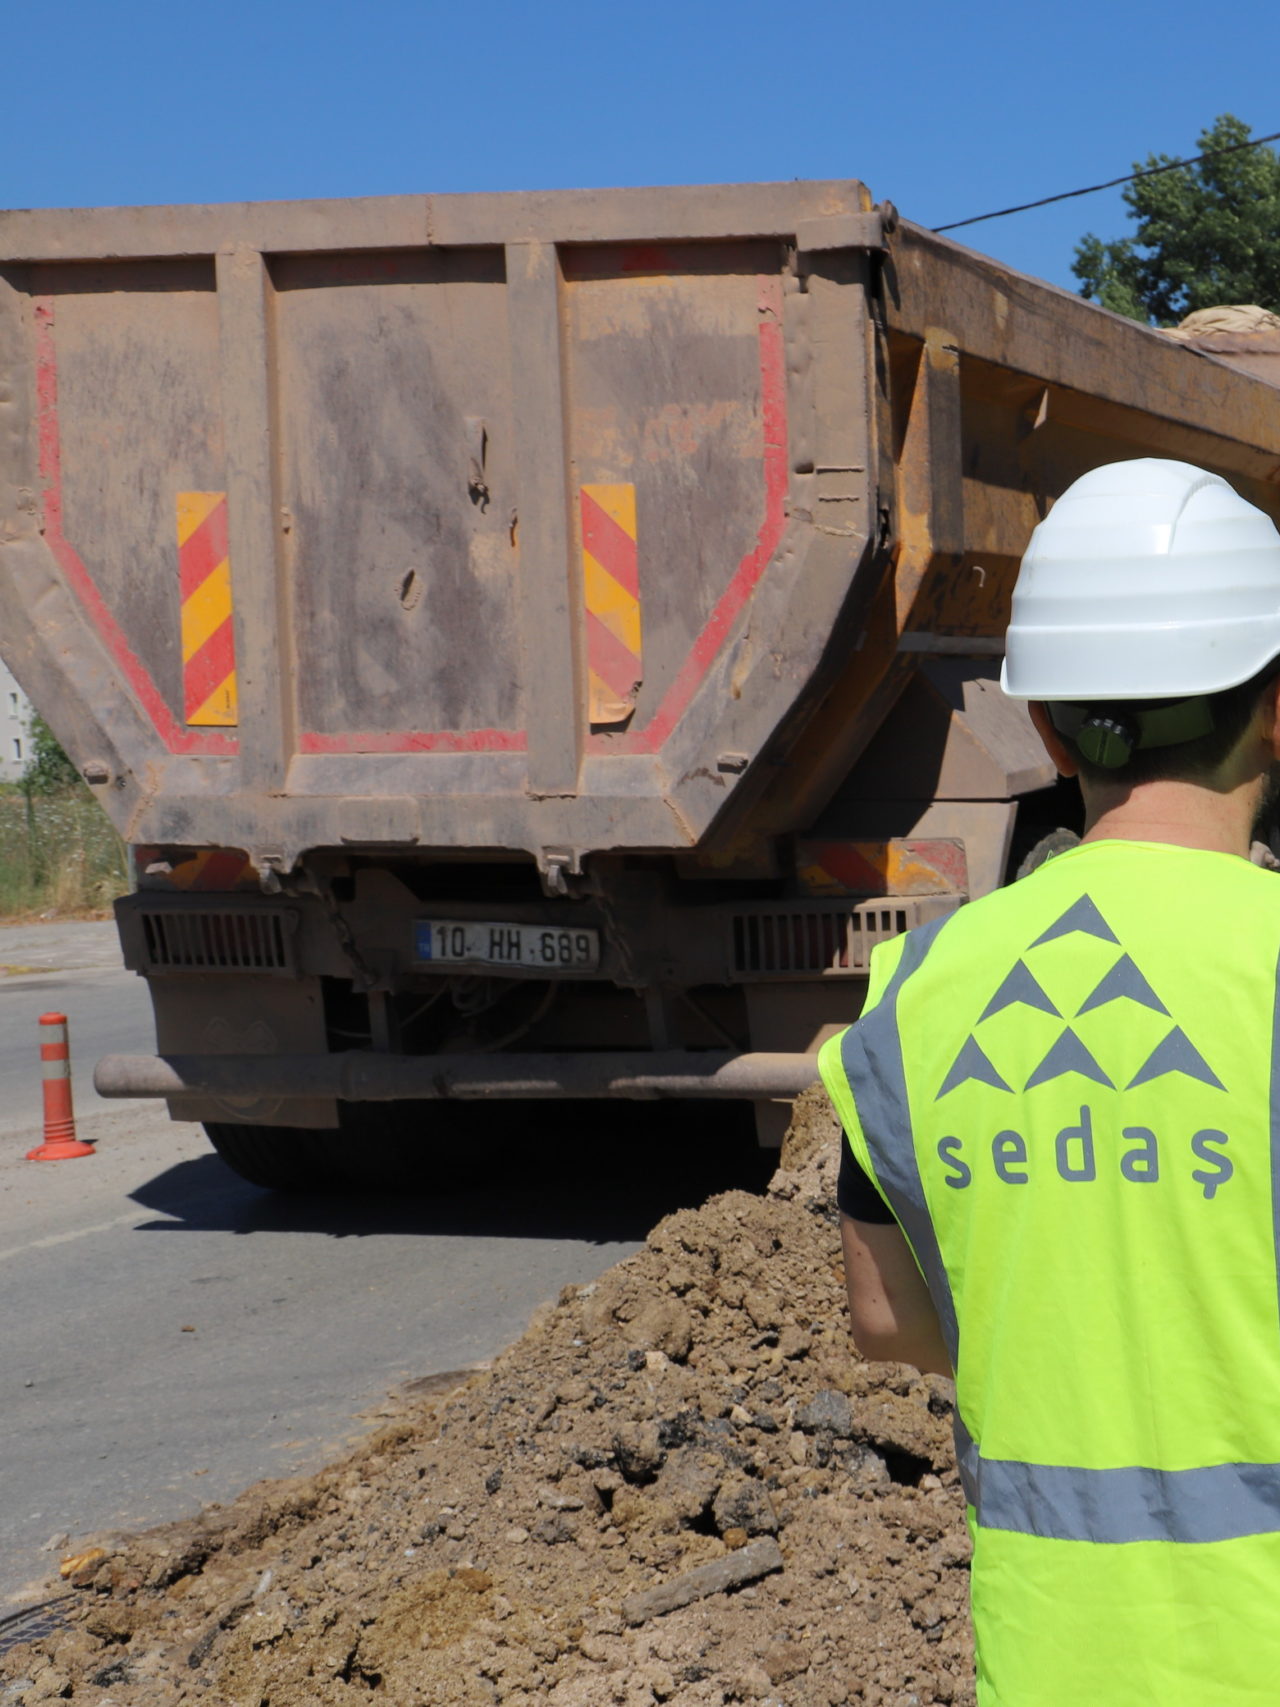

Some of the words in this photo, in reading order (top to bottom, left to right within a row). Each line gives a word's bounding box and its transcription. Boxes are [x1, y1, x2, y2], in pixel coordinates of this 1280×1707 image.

[437, 926, 466, 957] 10
[488, 929, 521, 961] HH
[540, 932, 591, 963] 689
[937, 1105, 1233, 1200] sedaş
